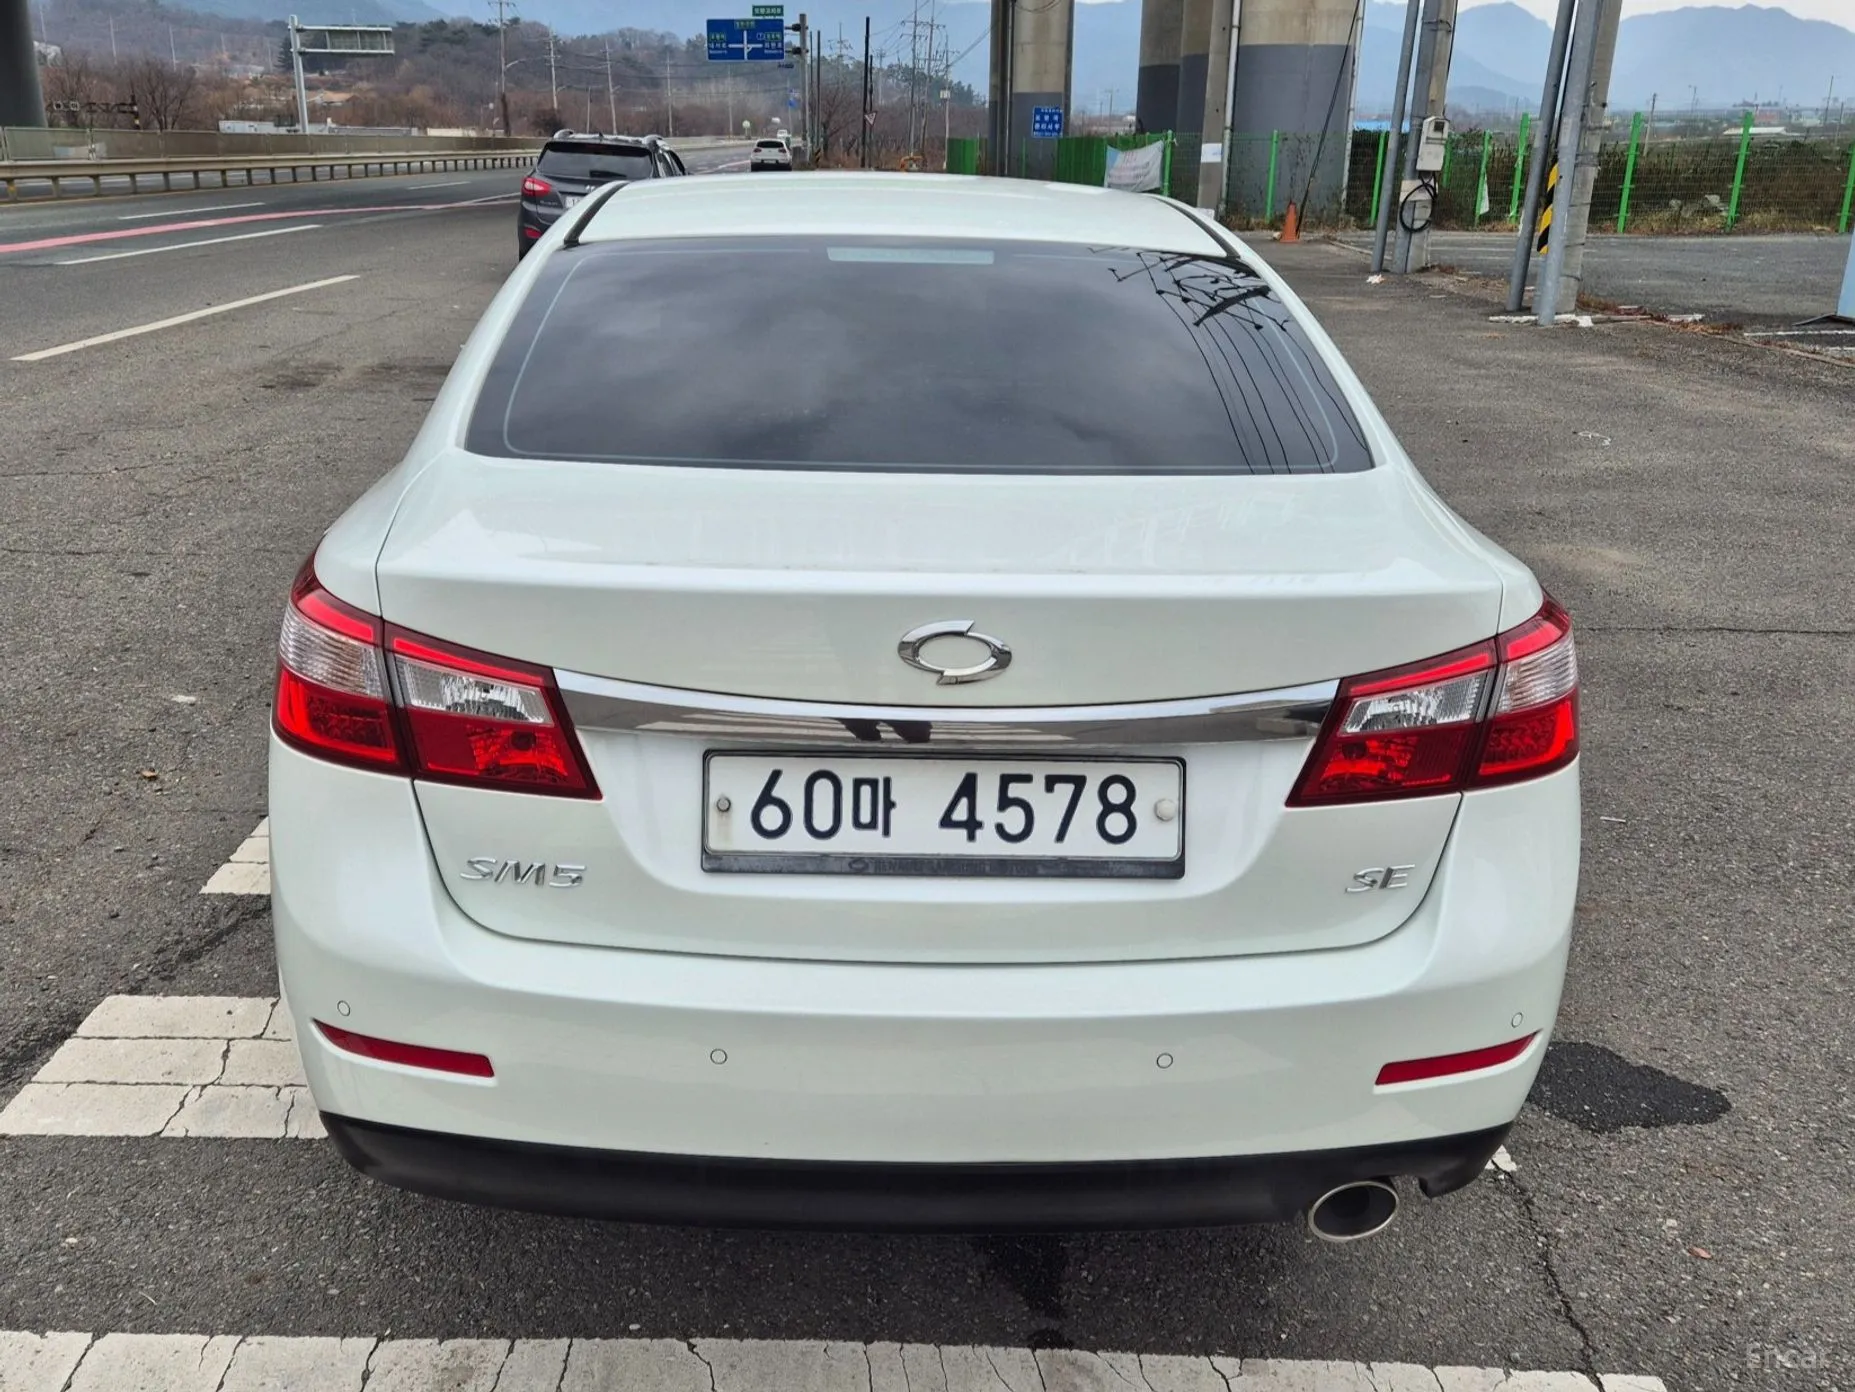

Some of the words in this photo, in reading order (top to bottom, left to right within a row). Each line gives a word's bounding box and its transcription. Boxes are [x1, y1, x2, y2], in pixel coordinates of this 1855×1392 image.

[750, 769, 897, 840] 60마
[937, 772, 1138, 845] 4578
[459, 857, 586, 888] SM5
[1345, 864, 1416, 893] SE
